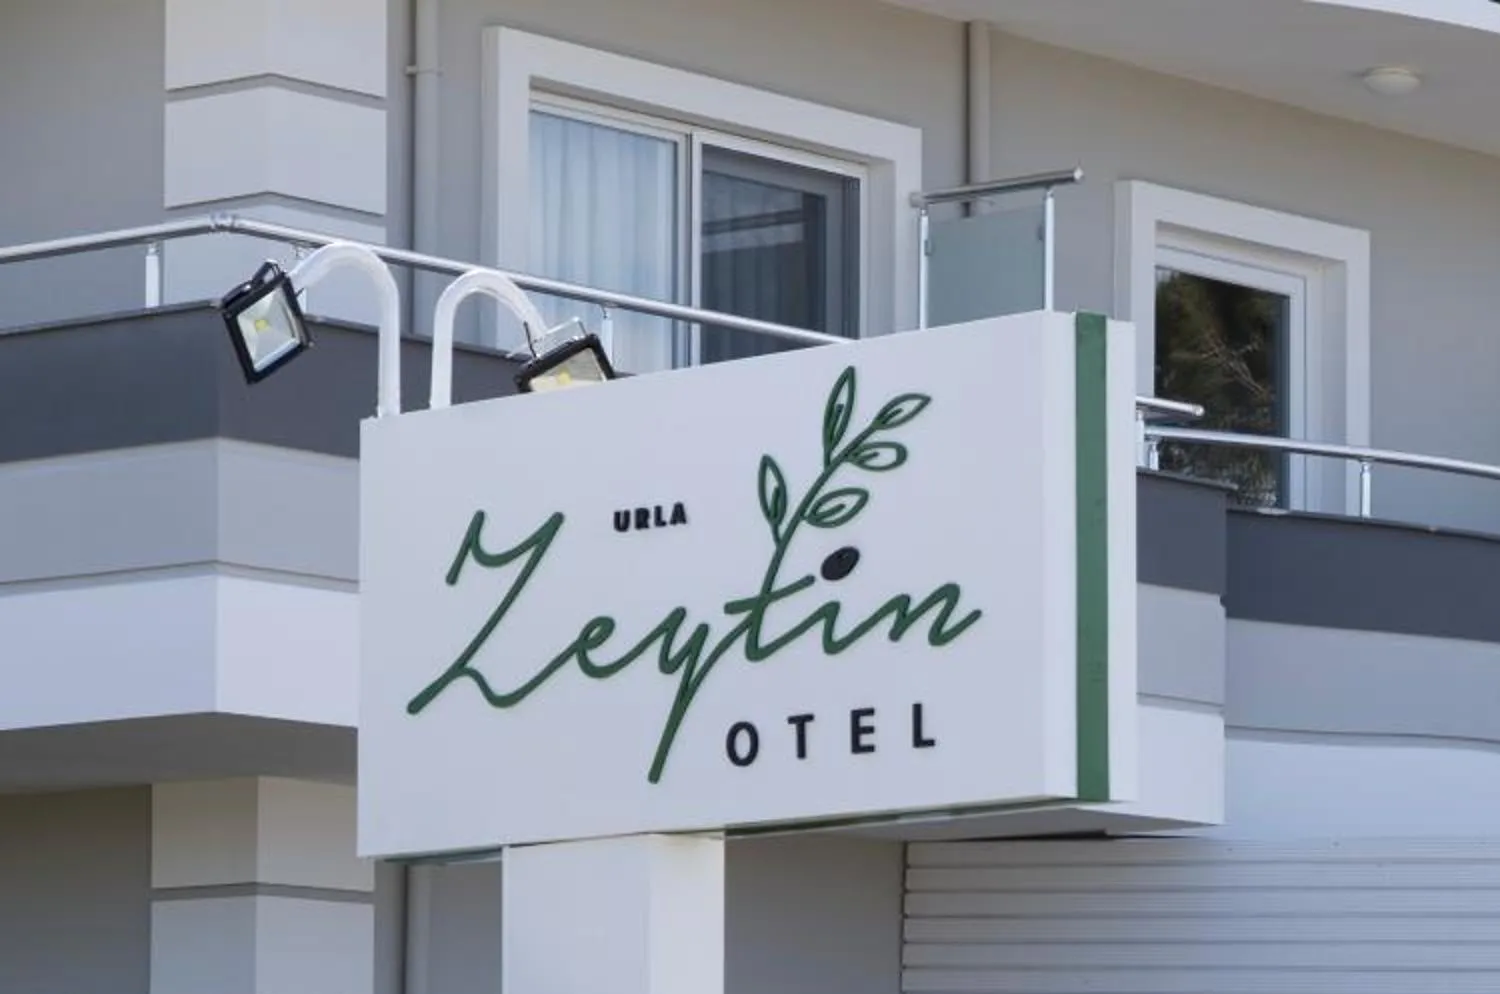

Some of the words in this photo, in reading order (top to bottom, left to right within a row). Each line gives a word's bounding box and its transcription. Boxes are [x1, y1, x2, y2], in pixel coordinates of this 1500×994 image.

[613, 502, 688, 532] URLA
[407, 510, 982, 784] Zeytin
[725, 702, 936, 767] OTEL
